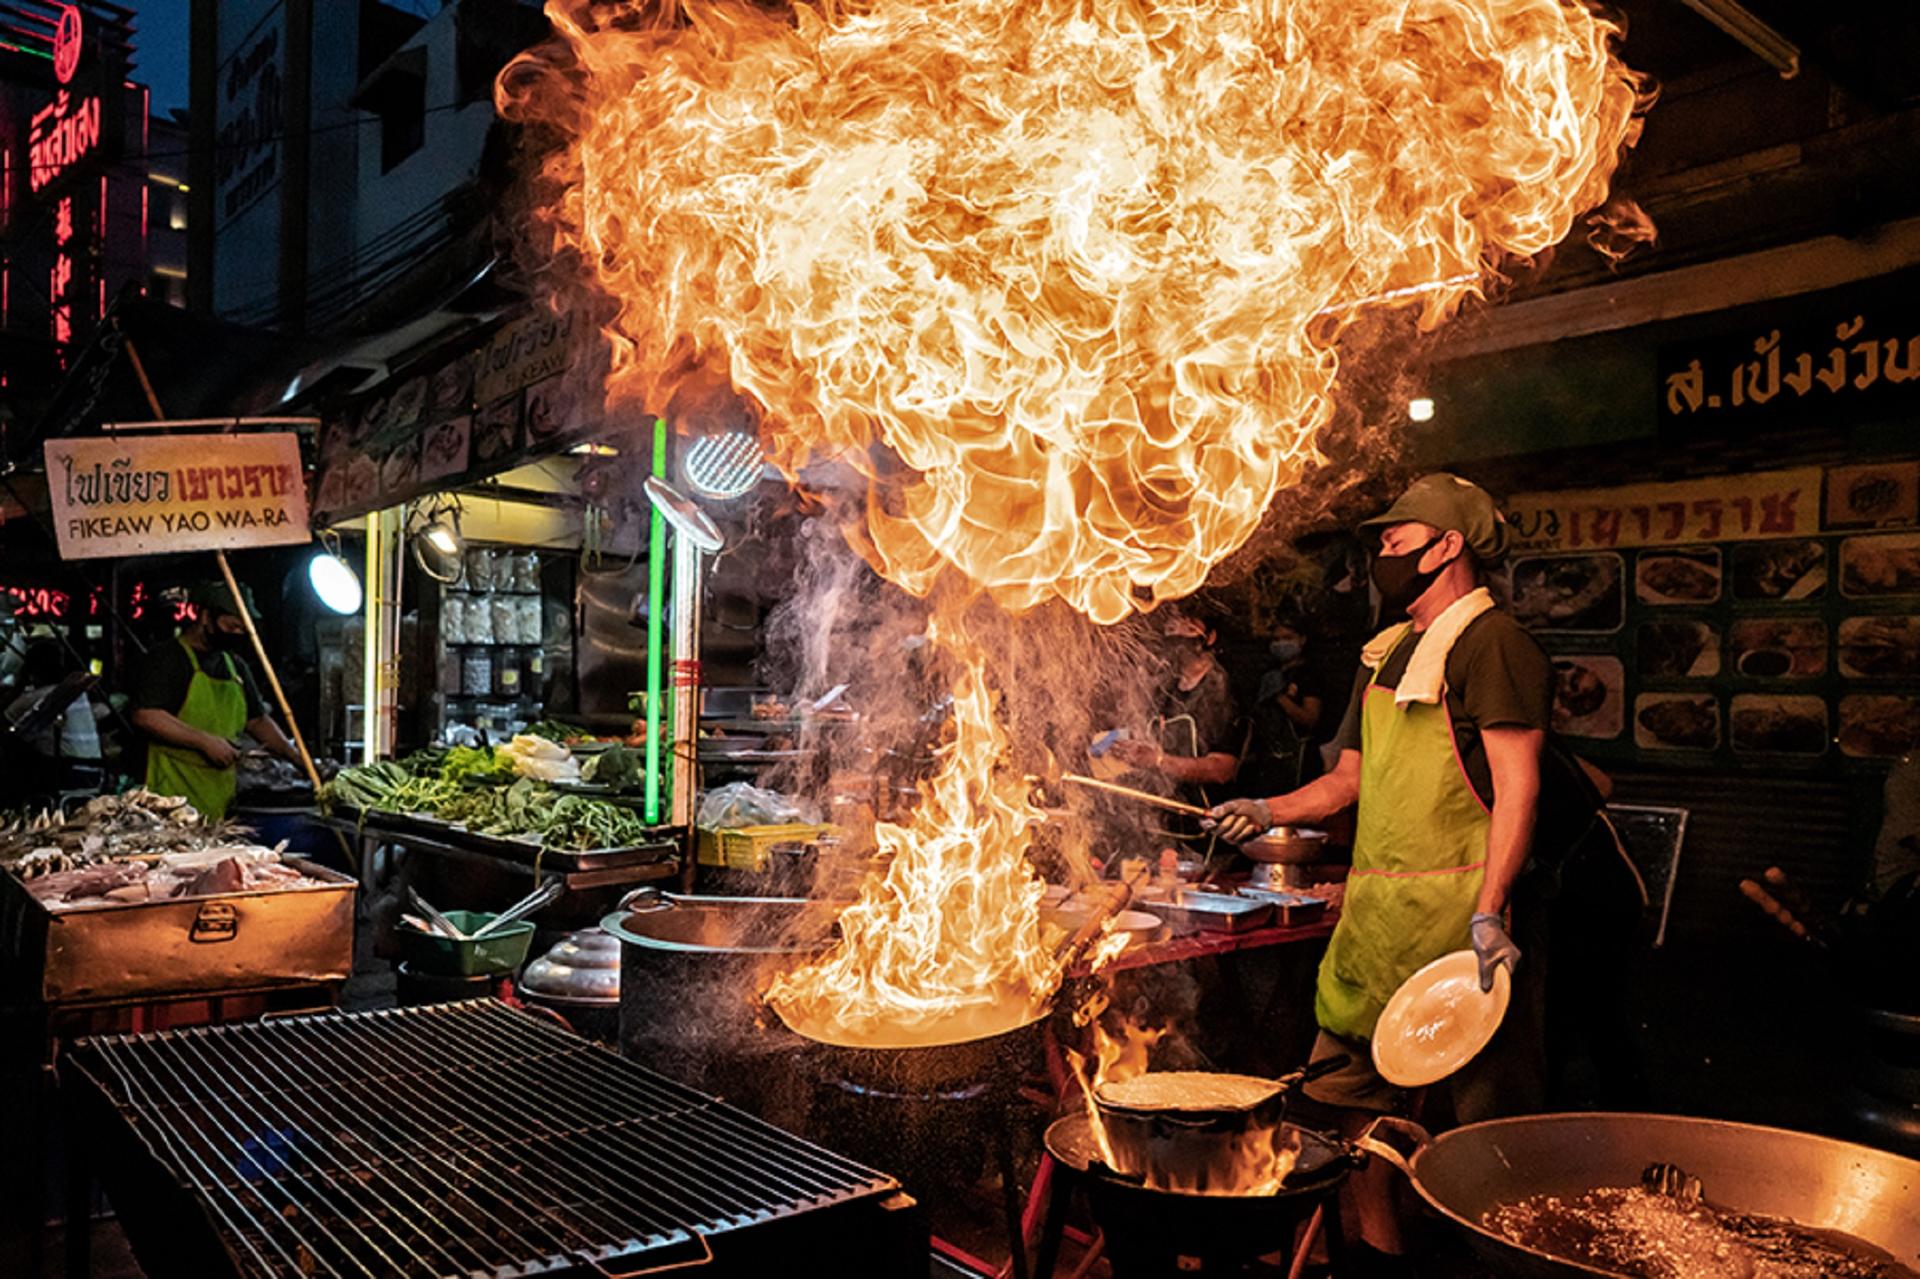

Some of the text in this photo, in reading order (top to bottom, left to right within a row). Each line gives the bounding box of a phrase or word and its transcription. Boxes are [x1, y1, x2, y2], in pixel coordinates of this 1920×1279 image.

[56, 455, 171, 507] ไฟเขียว
[69, 508, 291, 539] FIKEAW YAO WA-RA
